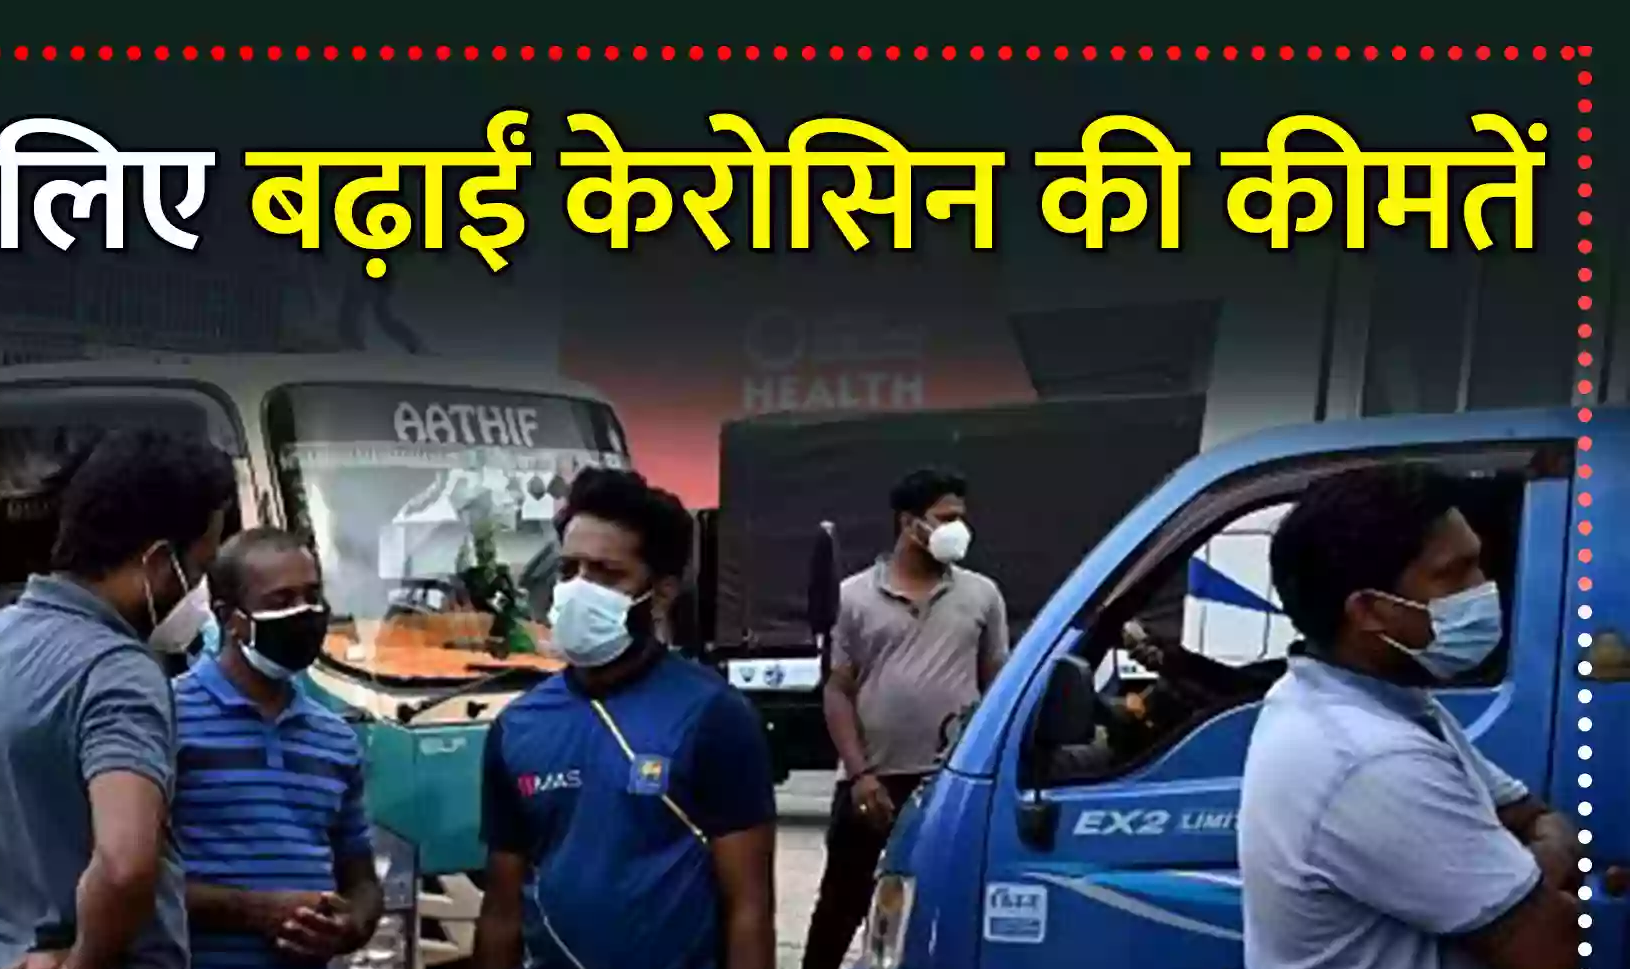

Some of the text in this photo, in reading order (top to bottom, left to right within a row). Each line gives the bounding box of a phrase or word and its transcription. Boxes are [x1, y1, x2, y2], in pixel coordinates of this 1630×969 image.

[742, 370, 925, 411] HEALTH
[393, 401, 539, 447] AATHIF
[1073, 809, 1171, 836] EX2
